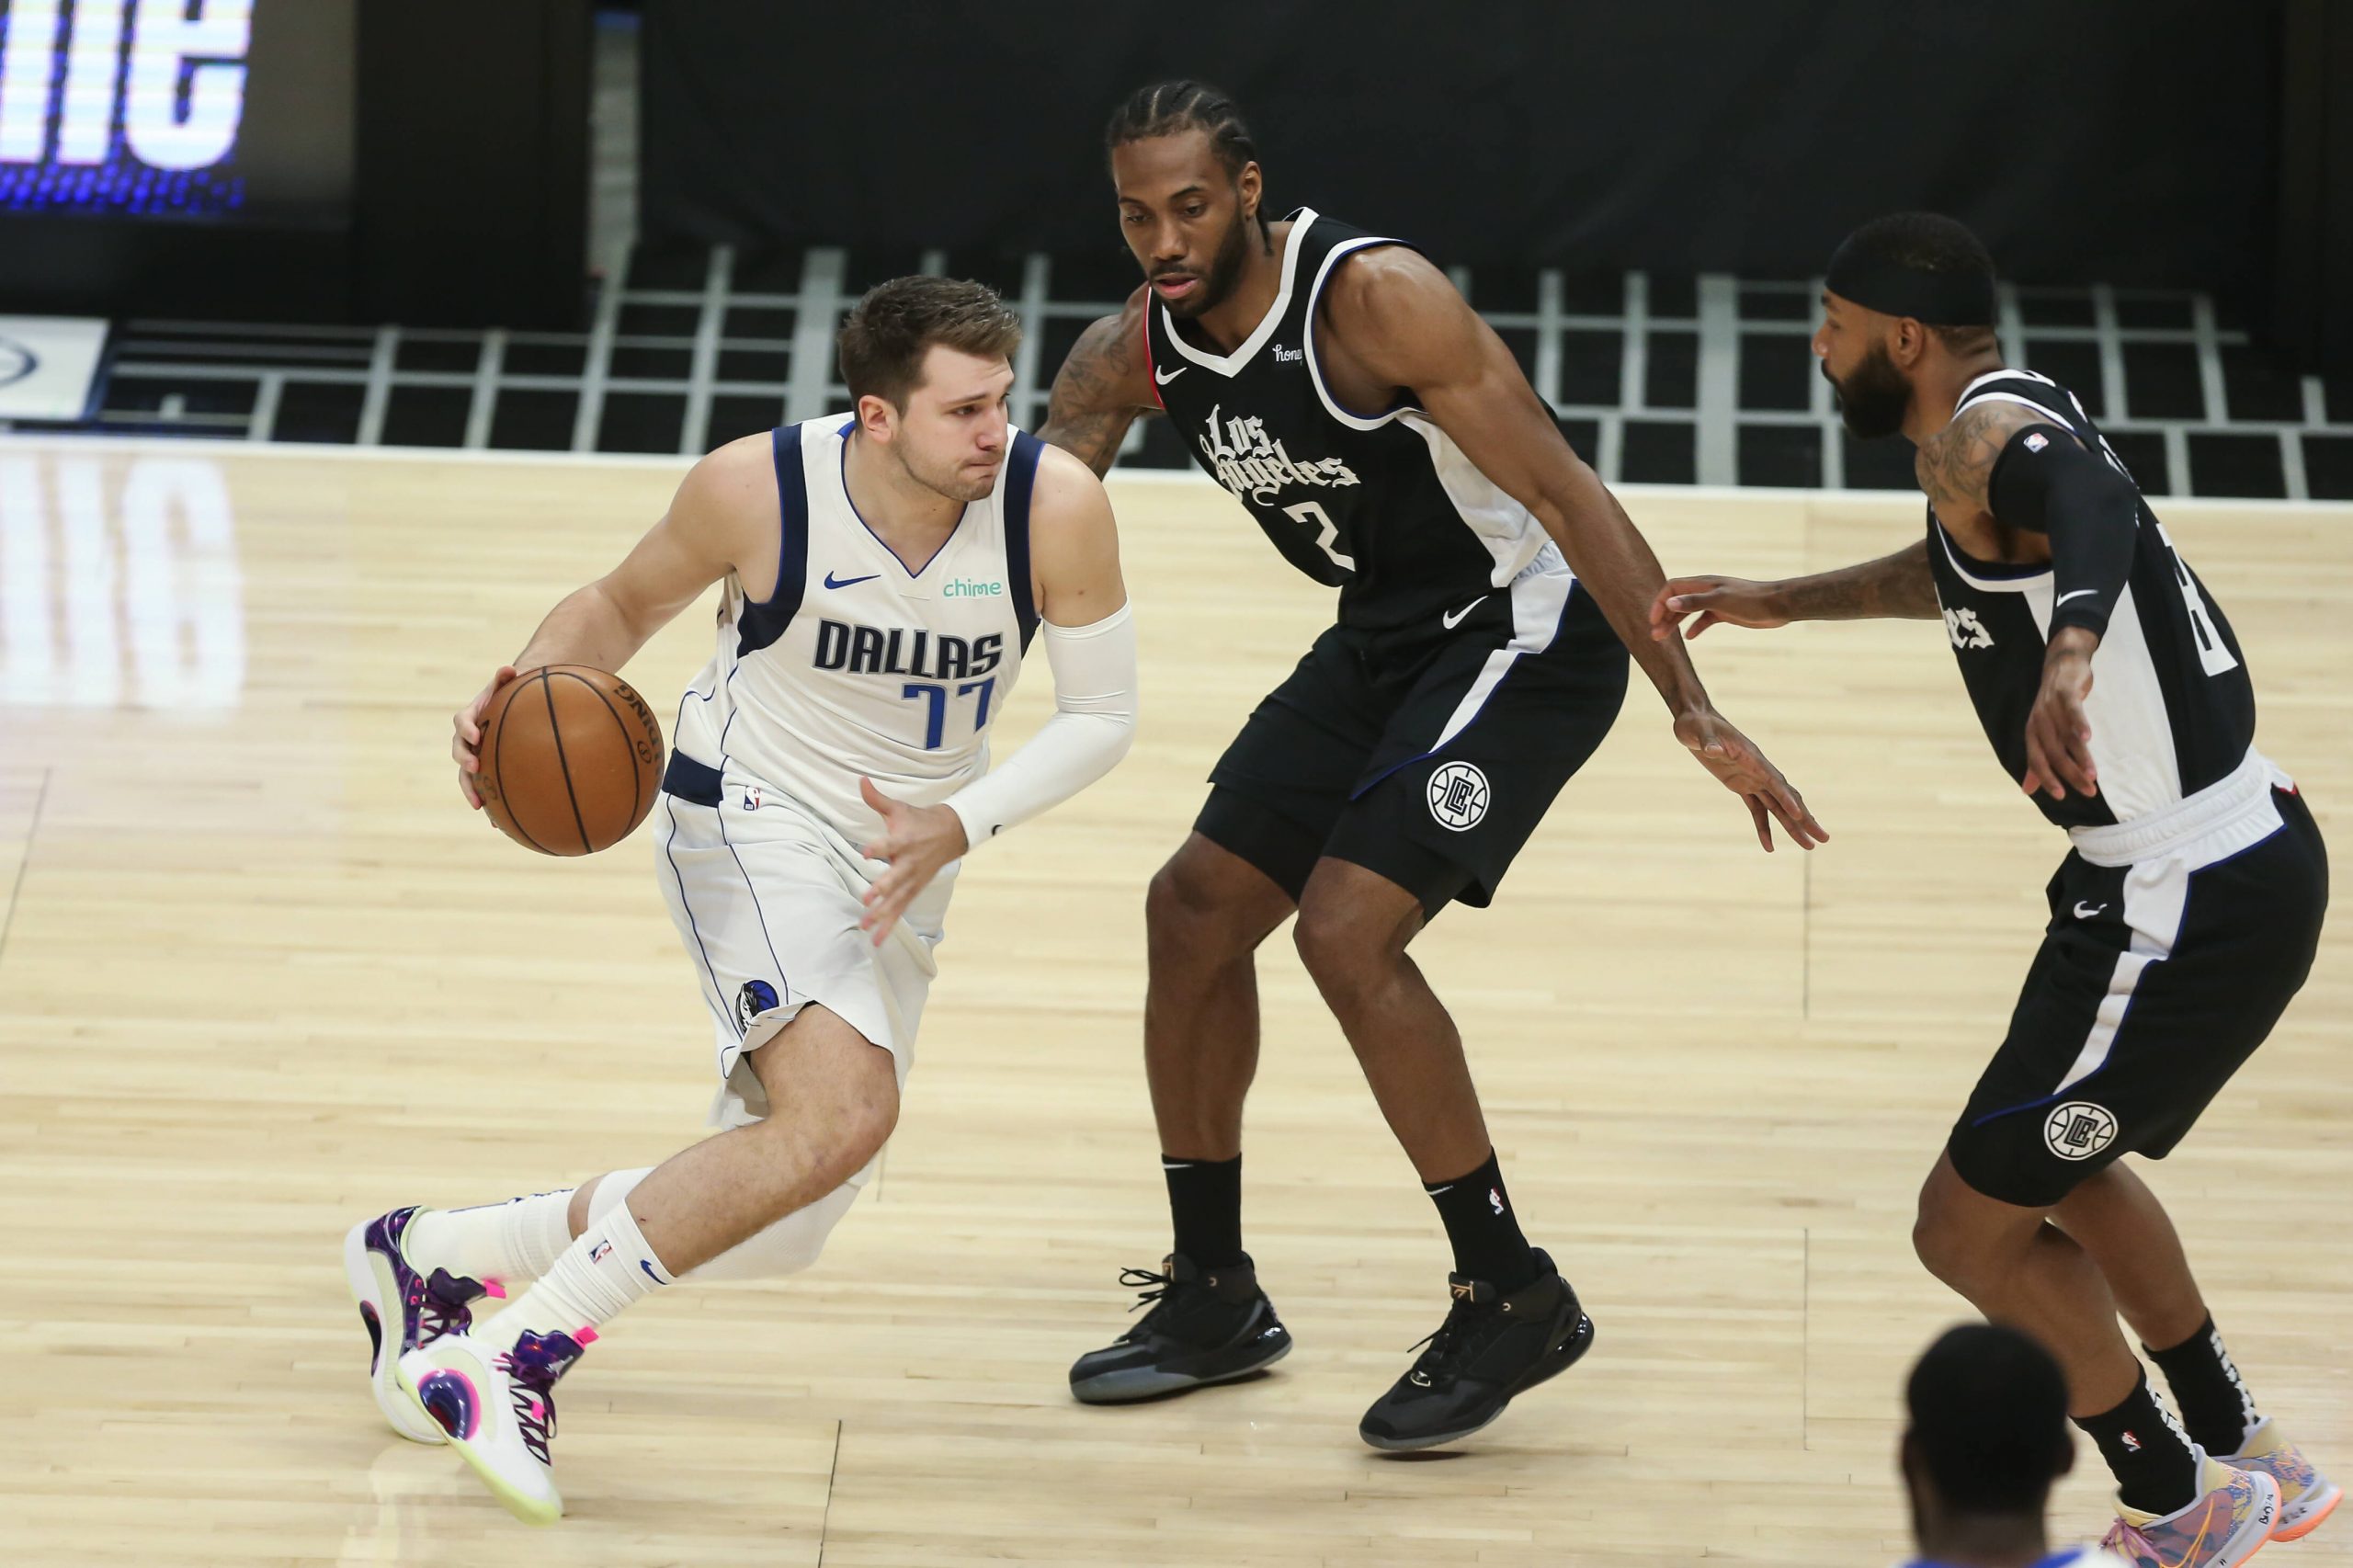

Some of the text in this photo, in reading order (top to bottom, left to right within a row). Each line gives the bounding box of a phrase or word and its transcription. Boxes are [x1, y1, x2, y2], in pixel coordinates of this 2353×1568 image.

[1205, 403, 1275, 460] Los
[1199, 437, 1361, 506] Angeles
[1281, 500, 1357, 572] 2
[943, 578, 1002, 597] chime
[812, 617, 1004, 680] DALLAS
[901, 675, 996, 750] 77
